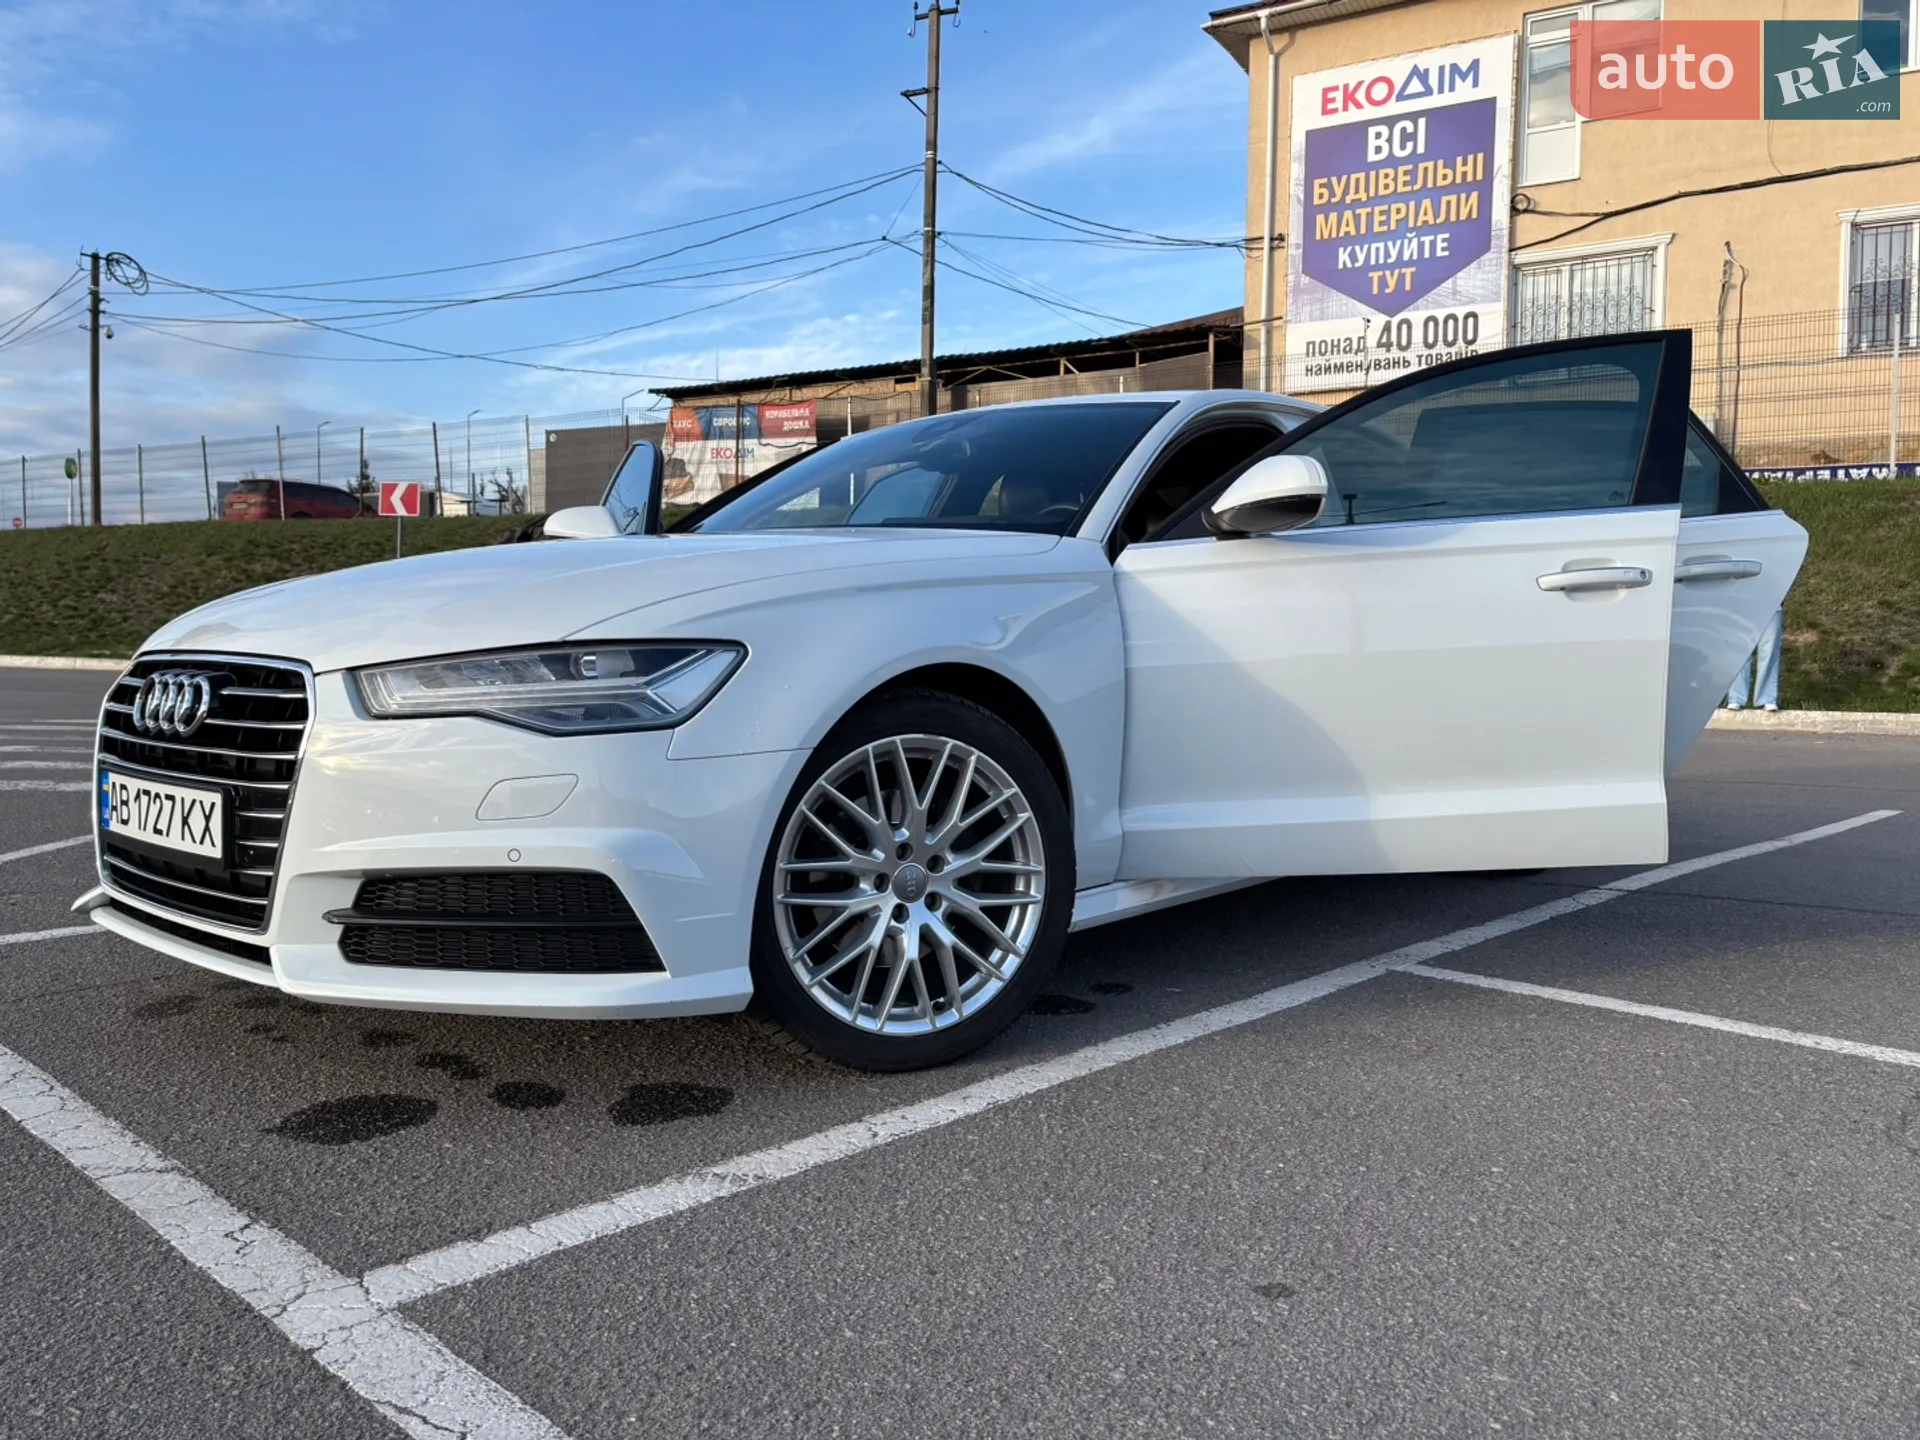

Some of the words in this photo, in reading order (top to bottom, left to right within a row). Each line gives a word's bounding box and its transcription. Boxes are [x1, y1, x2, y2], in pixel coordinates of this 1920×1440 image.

[1320, 58, 1481, 116] ЕКОДІМ
[1366, 117, 1427, 162] ВСІ
[1312, 152, 1485, 206] БУДІВЕЛЬНІ
[1315, 191, 1479, 240] МАТЕРІАЛИ
[1337, 233, 1450, 269] КУПУЙТЕ
[1369, 267, 1416, 295] ТУТ
[1305, 336, 1366, 358] понад
[1376, 318, 1412, 352] 40
[1423, 311, 1479, 349] 000
[109, 781, 131, 827] AB
[134, 787, 176, 838] 1727
[181, 796, 217, 848] KX
